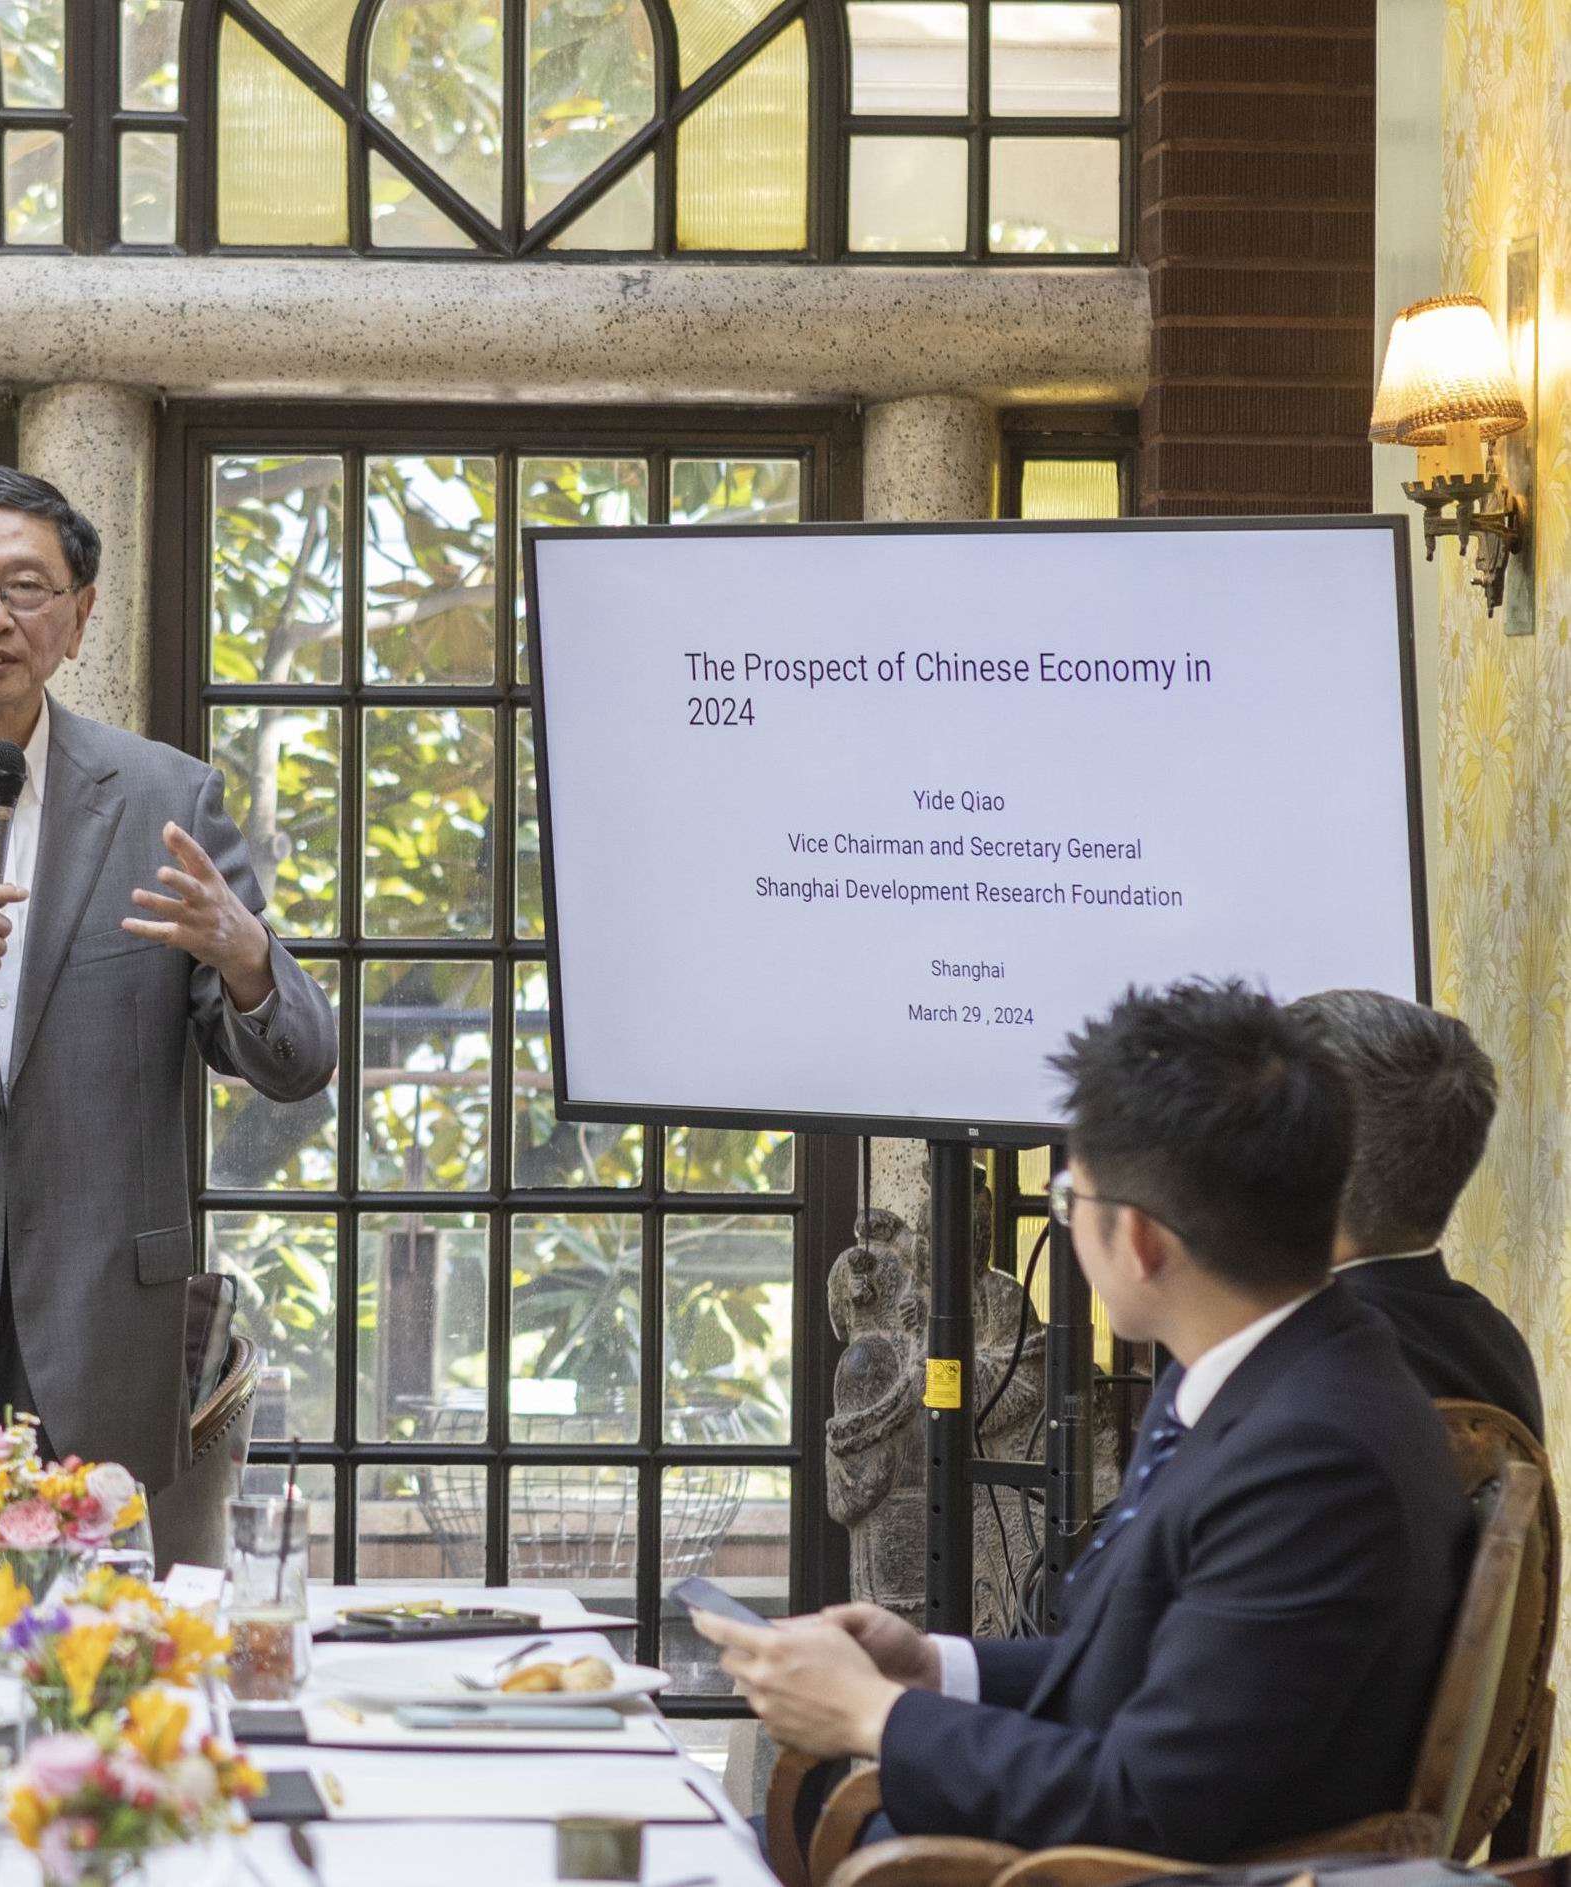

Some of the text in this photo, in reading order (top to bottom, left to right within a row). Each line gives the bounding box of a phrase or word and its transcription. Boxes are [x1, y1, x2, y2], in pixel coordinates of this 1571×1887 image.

[683, 650, 1212, 691] The Prospect of Chinese Economy in
[687, 696, 756, 727] 2024
[912, 788, 1005, 814] Yide Qiao
[787, 832, 1142, 864] Vice Chairman and Secretary General
[755, 875, 1183, 907] Shanghai Development Research Foundation
[930, 959, 1005, 983] Shanghai
[908, 1003, 958, 1024] March
[961, 1005, 982, 1024] 29
[993, 1005, 1035, 1025] 2024
